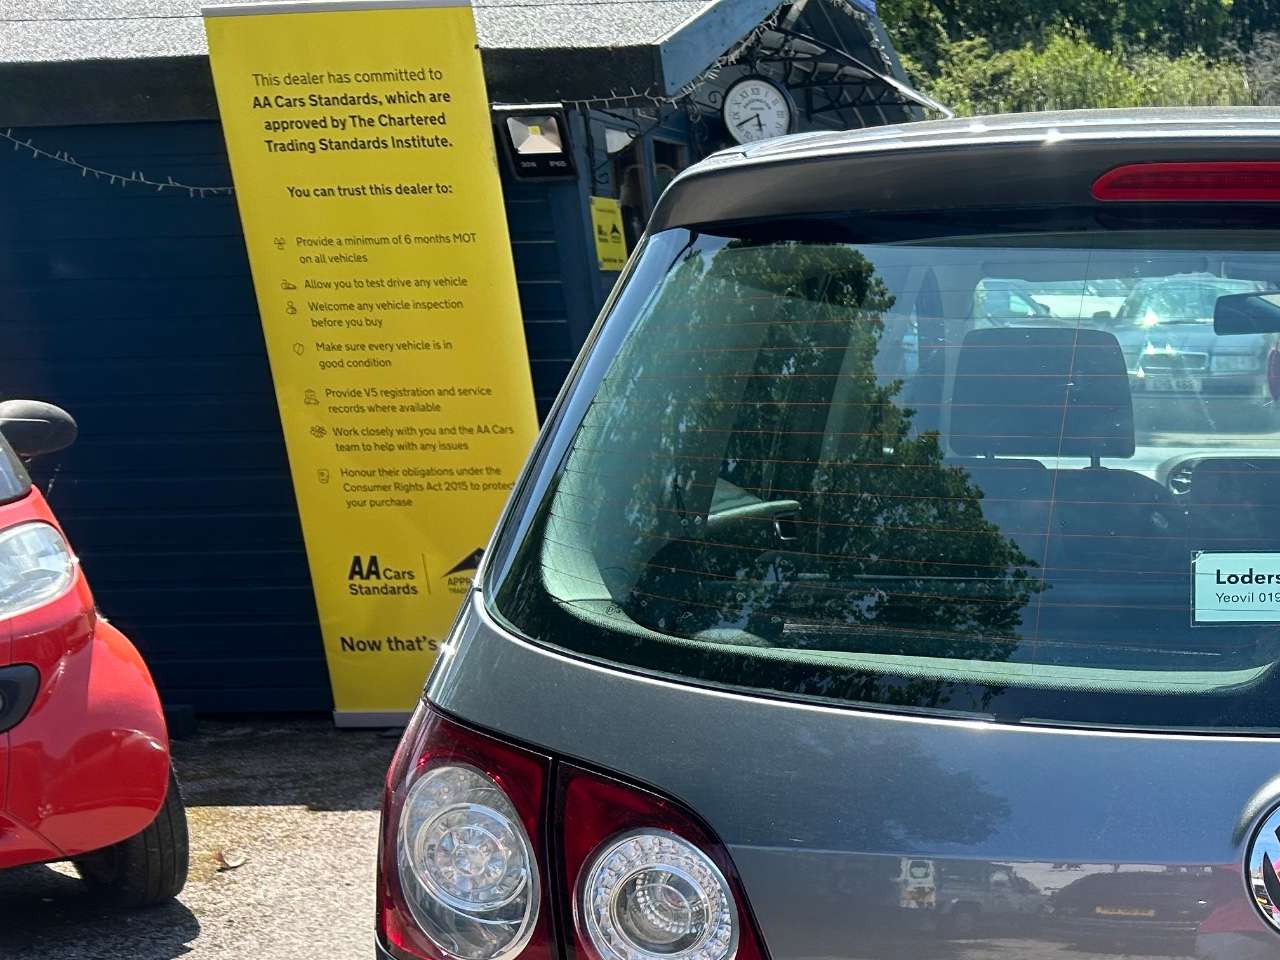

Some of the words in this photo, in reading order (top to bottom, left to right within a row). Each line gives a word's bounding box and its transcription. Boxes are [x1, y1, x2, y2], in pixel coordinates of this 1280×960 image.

[253, 73, 280, 87] This
[284, 72, 323, 85] dealer
[328, 71, 350, 84] has
[354, 68, 425, 83] committed
[429, 68, 442, 80] to
[253, 96, 272, 108] AA
[275, 94, 305, 107] Cars
[309, 93, 382, 106] Standards,
[385, 91, 425, 104] which
[429, 92, 450, 102] are
[264, 117, 326, 132] approved
[331, 116, 346, 130] by
[349, 115, 375, 127] The
[378, 113, 445, 126] Chartered
[265, 139, 315, 153] Trading
[319, 137, 387, 151] Standards
[391, 136, 453, 148] Institute.
[287, 187, 309, 198] You
[313, 187, 335, 197] can
[338, 186, 366, 196] trust
[369, 184, 392, 195] this
[395, 184, 432, 194] dealer
[436, 183, 453, 193] to:
[296, 236, 333, 247] Provide
[344, 235, 389, 246] minimum
[392, 235, 402, 244] of
[404, 235, 411, 244] 6
[414, 234, 450, 244] months
[453, 233, 476, 243] MOT
[300, 255, 312, 264] on
[315, 254, 326, 263] all
[328, 253, 367, 263] vehicles
[304, 279, 331, 289] Allow
[334, 280, 351, 290] you
[353, 279, 363, 288] to
[366, 278, 384, 287] test
[387, 277, 411, 287] drive
[414, 279, 430, 289] any
[433, 277, 467, 286] vehicle
[308, 301, 354, 311] Welcome
[357, 302, 373, 312] any
[376, 300, 410, 310] vehicle
[413, 300, 463, 311] inspection
[311, 318, 343, 327] before
[345, 319, 362, 328] you
[365, 318, 382, 328] buy
[316, 342, 342, 351] Make
[344, 343, 366, 351] sure
[368, 343, 394, 353] every
[396, 341, 430, 350] vehicle
[433, 341, 441, 349] is
[443, 340, 452, 349] in
[319, 359, 344, 369] good
[347, 358, 391, 368] condition
[325, 388, 362, 398] Provide
[364, 387, 378, 397] V5
[380, 387, 434, 398] registration
[437, 387, 454, 396] and
[456, 387, 491, 396] service
[328, 404, 366, 413] records
[368, 403, 397, 412] where
[399, 403, 440, 412] available
[332, 426, 357, 436] Work
[360, 426, 394, 437] closely
[396, 426, 416, 435] with
[419, 427, 436, 437] you
[439, 426, 456, 435] and
[459, 425, 473, 434] the
[476, 424, 490, 434] AA
[493, 425, 513, 434] Cars
[336, 443, 359, 452] team
[362, 443, 372, 451] to
[374, 442, 394, 452] help
[397, 442, 417, 451] with
[420, 443, 436, 452] any
[438, 441, 468, 450] issues
[340, 468, 375, 478] Honour
[378, 468, 400, 477] their
[402, 467, 454, 477] obligations
[456, 467, 483, 476] under
[485, 466, 501, 475] the
[343, 483, 391, 492] Consumer
[394, 482, 424, 493] Rights
[427, 482, 442, 490] Act
[445, 482, 468, 490] 2015
[470, 482, 480, 490] to
[346, 499, 367, 509] your
[370, 498, 412, 508] purchase
[348, 556, 380, 580] AA
[383, 568, 415, 580] Cars
[349, 584, 418, 595] Standards
[1215, 592, 1254, 603] Yeovil
[340, 637, 381, 651] Now
[388, 636, 438, 651] that's
